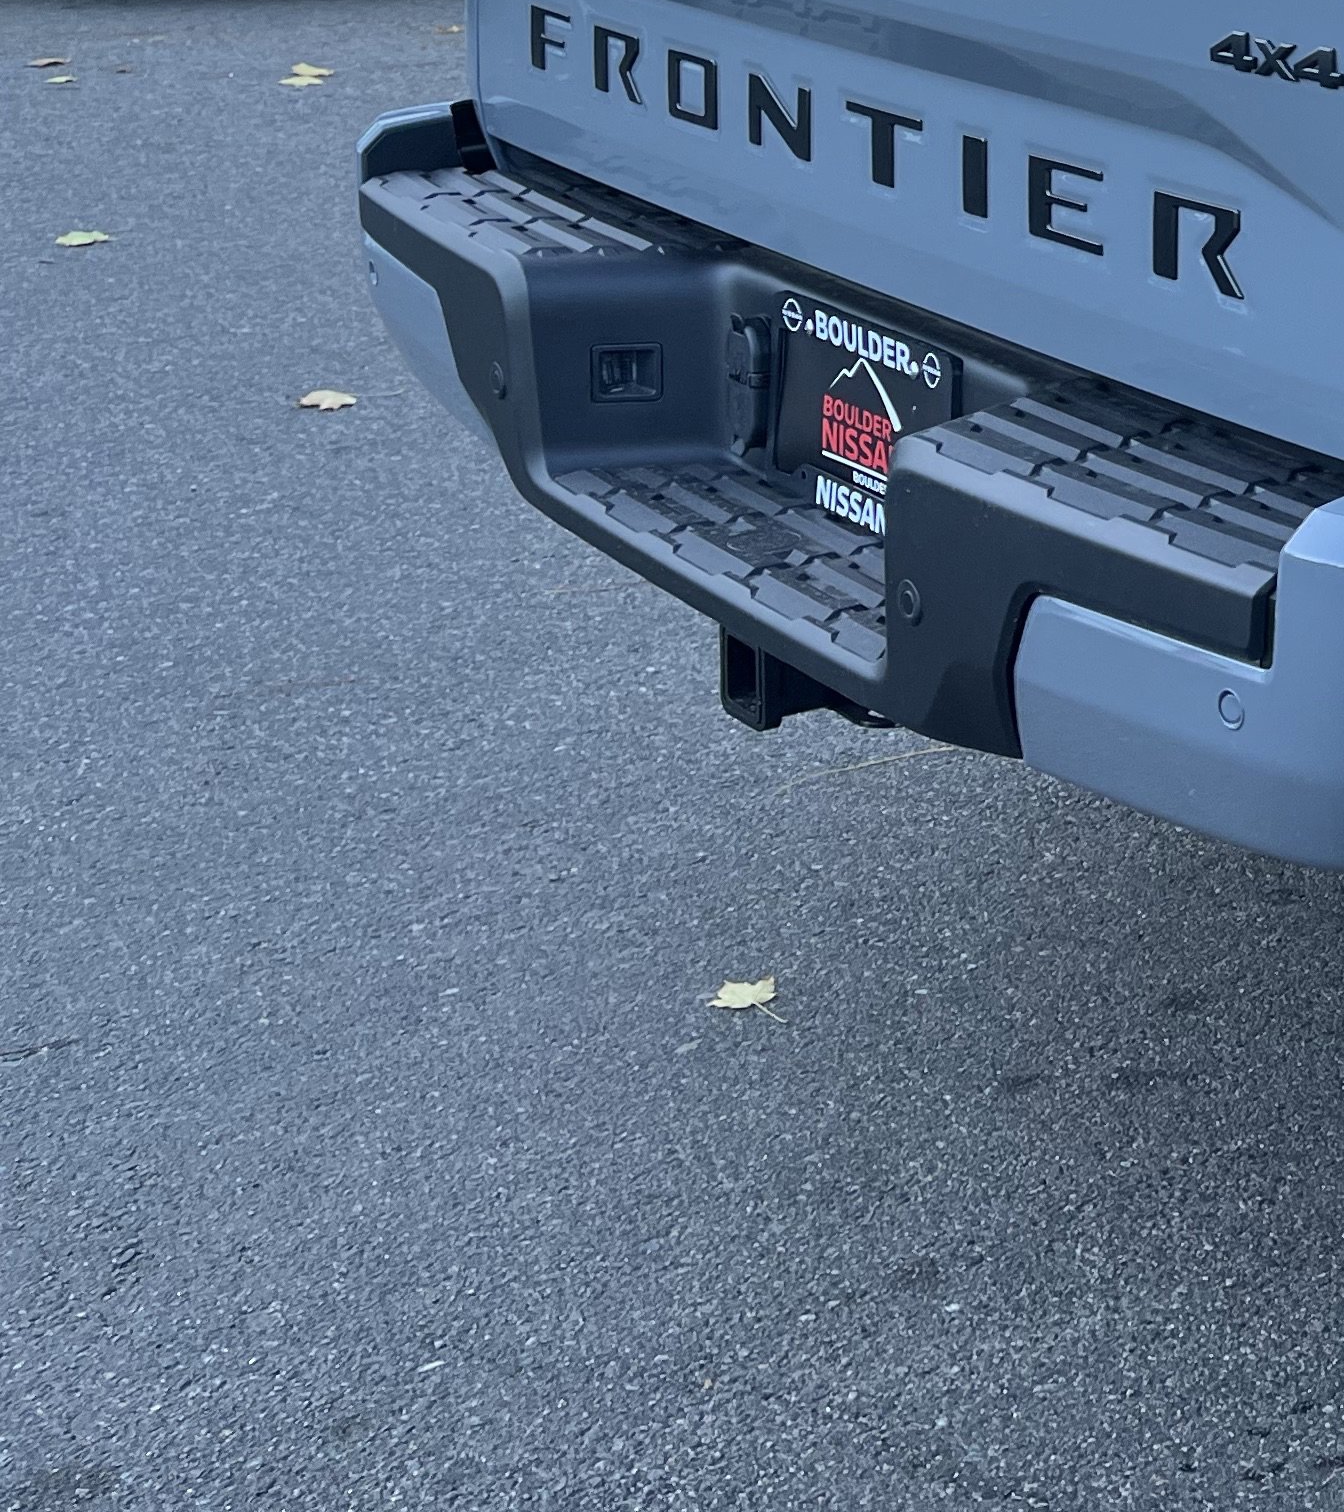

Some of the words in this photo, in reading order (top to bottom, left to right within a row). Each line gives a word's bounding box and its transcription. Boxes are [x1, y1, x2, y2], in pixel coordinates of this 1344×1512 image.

[529, 4, 1244, 300] FRONTIER
[814, 309, 912, 376] BOULDER
[823, 393, 893, 442] BOULDER
[822, 418, 894, 474] NISSA
[853, 471, 887, 496] BOULDE
